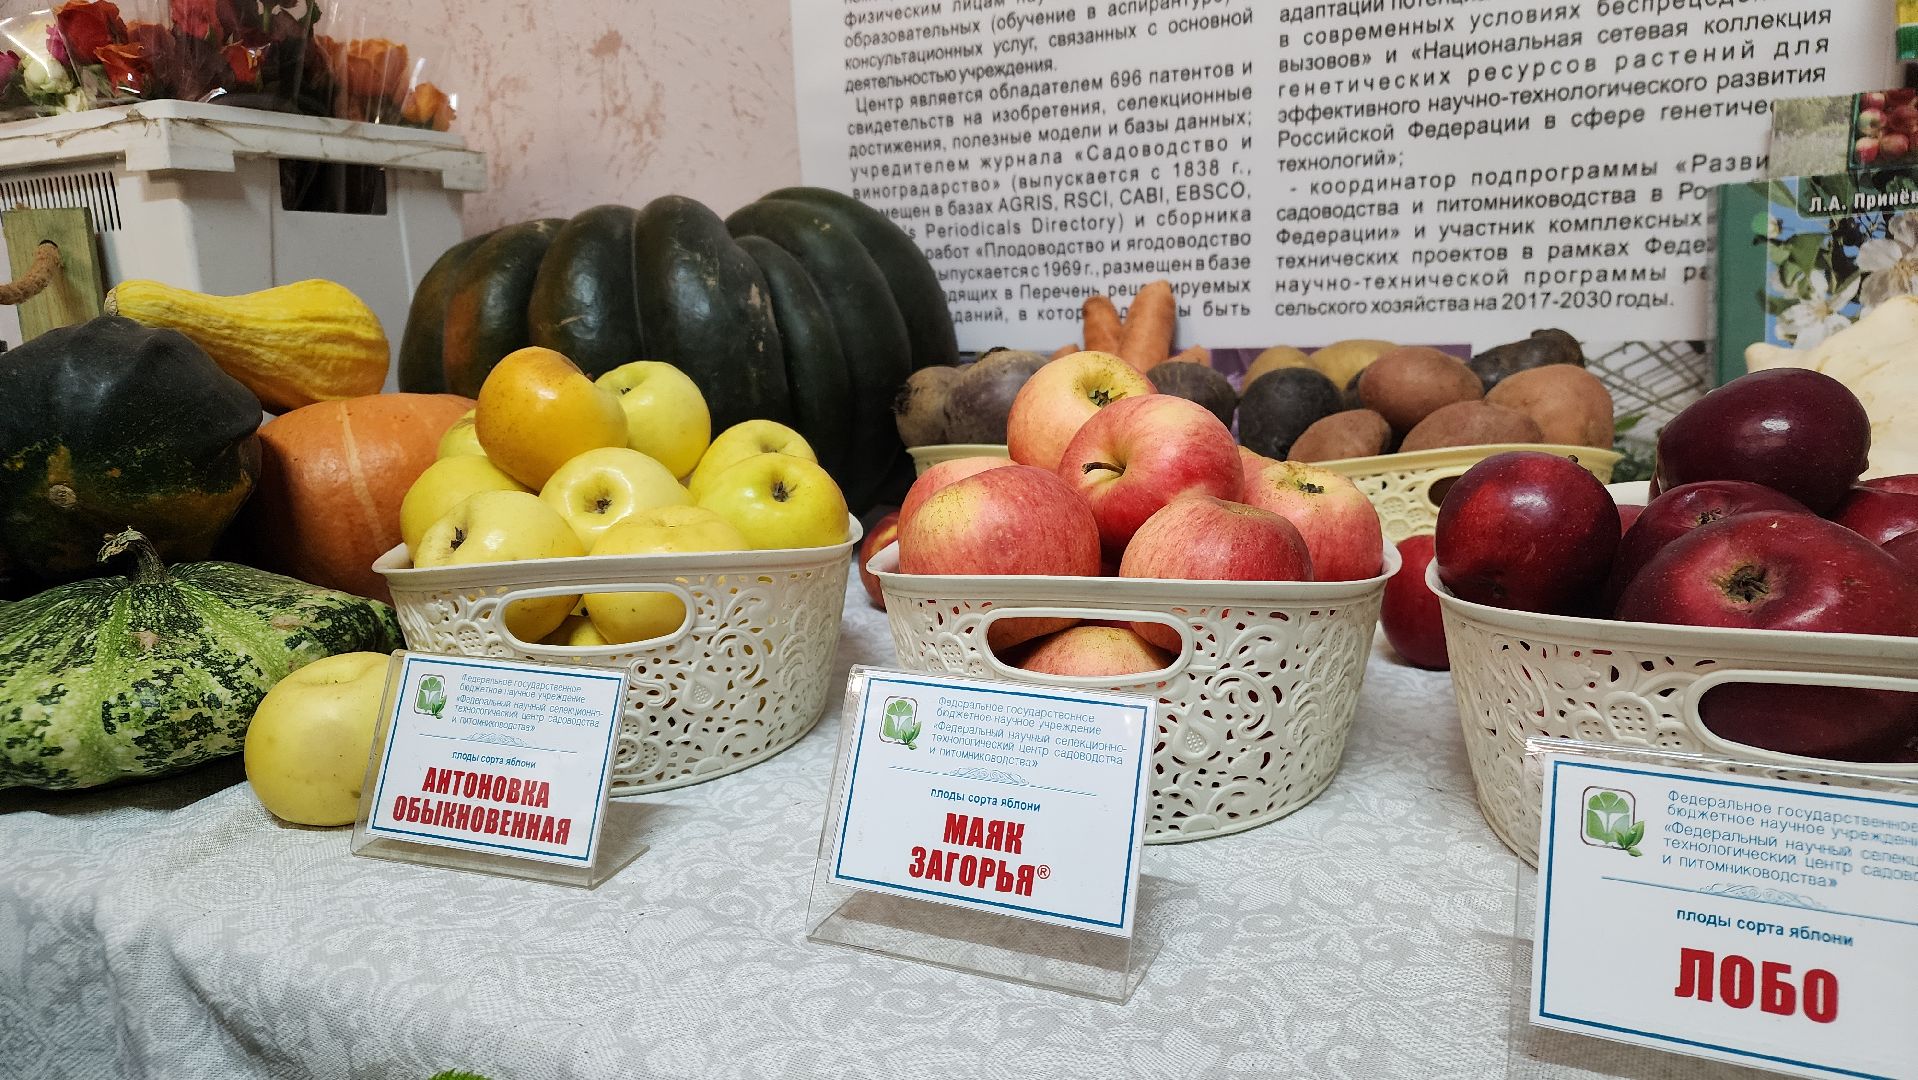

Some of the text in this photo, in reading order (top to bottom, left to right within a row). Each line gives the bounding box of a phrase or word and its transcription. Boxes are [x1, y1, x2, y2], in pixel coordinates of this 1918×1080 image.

[845, 3, 941, 29] физическим
[845, 21, 980, 48] образовательных
[992, 9, 1075, 34] (обучение
[1087, 6, 1096, 20] в
[1280, 0, 1384, 24] адаптации
[1280, 35, 1289, 47] в
[1304, 17, 1454, 46] современных
[1471, 5, 1580, 34] условиях
[846, 7, 1252, 70] консультационных услуг, связанных с основной
[1279, 9, 1831, 73] вызовов» и «Национальная сетевая коллекция
[845, 58, 1056, 94] деятельностью учреждения.
[1279, 38, 1828, 98] генетических ресурсов растений для
[856, 61, 1252, 116] Центр является обладателем 696 патентов и
[1278, 67, 1825, 126] эффективного научно-технологического развития
[848, 86, 1252, 135] свидетельств на изобретения, селекционные
[1278, 99, 1773, 148] Российской Федерации в сфере генетиче
[850, 112, 1251, 159] достижения, полезные модели и базы данных;
[851, 136, 1251, 182] учредителем журнала «Садоводство и
[1278, 150, 1404, 172] технологий»;
[1311, 154, 1769, 197] координатор подпрограммы «Разви
[853, 159, 1251, 200] виноградарство» (выпускается с 1838 г.,
[881, 181, 1251, 220] мещен в базах AGRIS, RSCI, CABI, EBSCO,
[1277, 202, 1398, 222] садоводства
[1413, 201, 1423, 214] и
[1437, 189, 1635, 212] питомниководства
[1651, 188, 1662, 202] в
[1809, 188, 1918, 212] Л.А. Принёв
[926, 220, 1021, 238] Periodicals
[1032, 213, 1123, 234] Directory)
[1135, 215, 1144, 228] и
[1157, 209, 1251, 228] сборника
[1277, 213, 1701, 247] Федерации» и участник комплексных
[976, 241, 1104, 258] «Плодоводство
[1111, 240, 1120, 252] и
[1127, 233, 1251, 251] ягодоводство
[1277, 252, 1398, 269] технических
[1413, 247, 1507, 267] проектов
[1522, 246, 1533, 259] в
[1548, 242, 1628, 263] рамках
[939, 254, 1250, 283] ыпускается с 1969 г., размещен в базе
[1276, 268, 1508, 296] научно-технической
[1525, 267, 1666, 288] программы
[948, 289, 997, 303] дящих
[1005, 289, 1013, 300] в
[955, 307, 1008, 324] даний,
[1019, 309, 1027, 321] в
[1203, 300, 1250, 316] быть
[1275, 290, 1673, 316] сельского хозяйства на 2017-2030 годы.
[423, 767, 549, 808] АНТОНОВКА
[931, 789, 1040, 812] плоды сорта яблони
[393, 795, 571, 845] ОБЫКНОВЕННАЯ
[1668, 790, 1918, 831] Федеральное государственное
[1668, 804, 1754, 825] бюджетное
[1761, 819, 1824, 834] научное
[943, 812, 1025, 855] МАЯК
[1665, 822, 1777, 847] «Федеральный
[1862, 850, 1918, 867] селекц
[1663, 855, 1837, 887] и питомниководства»
[1664, 838, 1796, 864] технологический
[1806, 858, 1852, 875] центр
[1677, 910, 1853, 946] плоды сорта яблони
[1674, 947, 1839, 1024] ЛОБО
